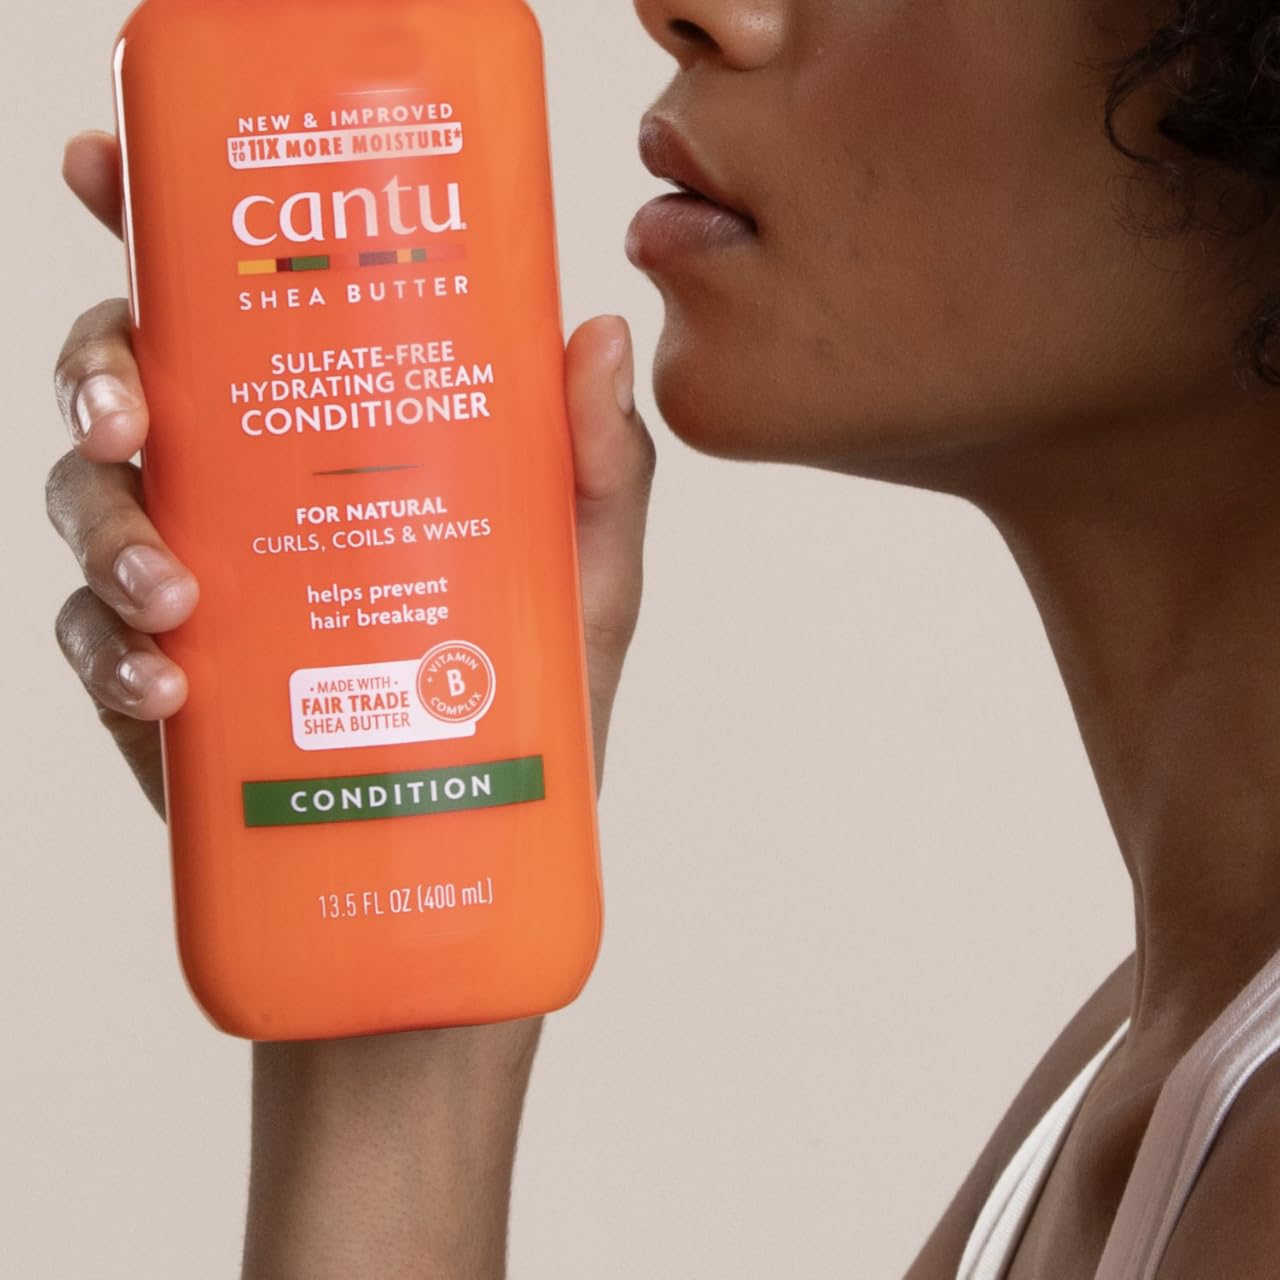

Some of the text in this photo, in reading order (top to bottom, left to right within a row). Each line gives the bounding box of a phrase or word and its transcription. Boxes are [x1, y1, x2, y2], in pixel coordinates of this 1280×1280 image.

[239, 103, 453, 132] NEW & IMPROVED
[231, 140, 245, 151] UP
[232, 152, 246, 162] TO
[248, 138, 281, 161] 11X
[286, 136, 343, 158] MORE
[232, 175, 462, 246] cantu
[239, 275, 468, 310] SHEA BUTTER
[271, 340, 455, 375] SULFATE-FREE
[230, 363, 494, 404] HYDRATING CREAM
[241, 392, 491, 436] CONDITIONER
[296, 496, 448, 525] FOR NATURAL
[253, 518, 491, 555] CURLS, COILS & WAVES
[307, 576, 449, 607] helps prevent
[310, 604, 449, 630] hair breakage
[428, 652, 479, 673] VITAMIN
[317, 676, 391, 694] MADE WITH
[446, 669, 465, 697] B
[301, 691, 411, 716] FAIR TRADE
[430, 691, 482, 715] COMPLEX
[304, 712, 411, 735] SHEA BUTTER
[290, 774, 492, 813] CONDITION
[319, 877, 494, 919] 13.5 FL OZ (400 mL)
